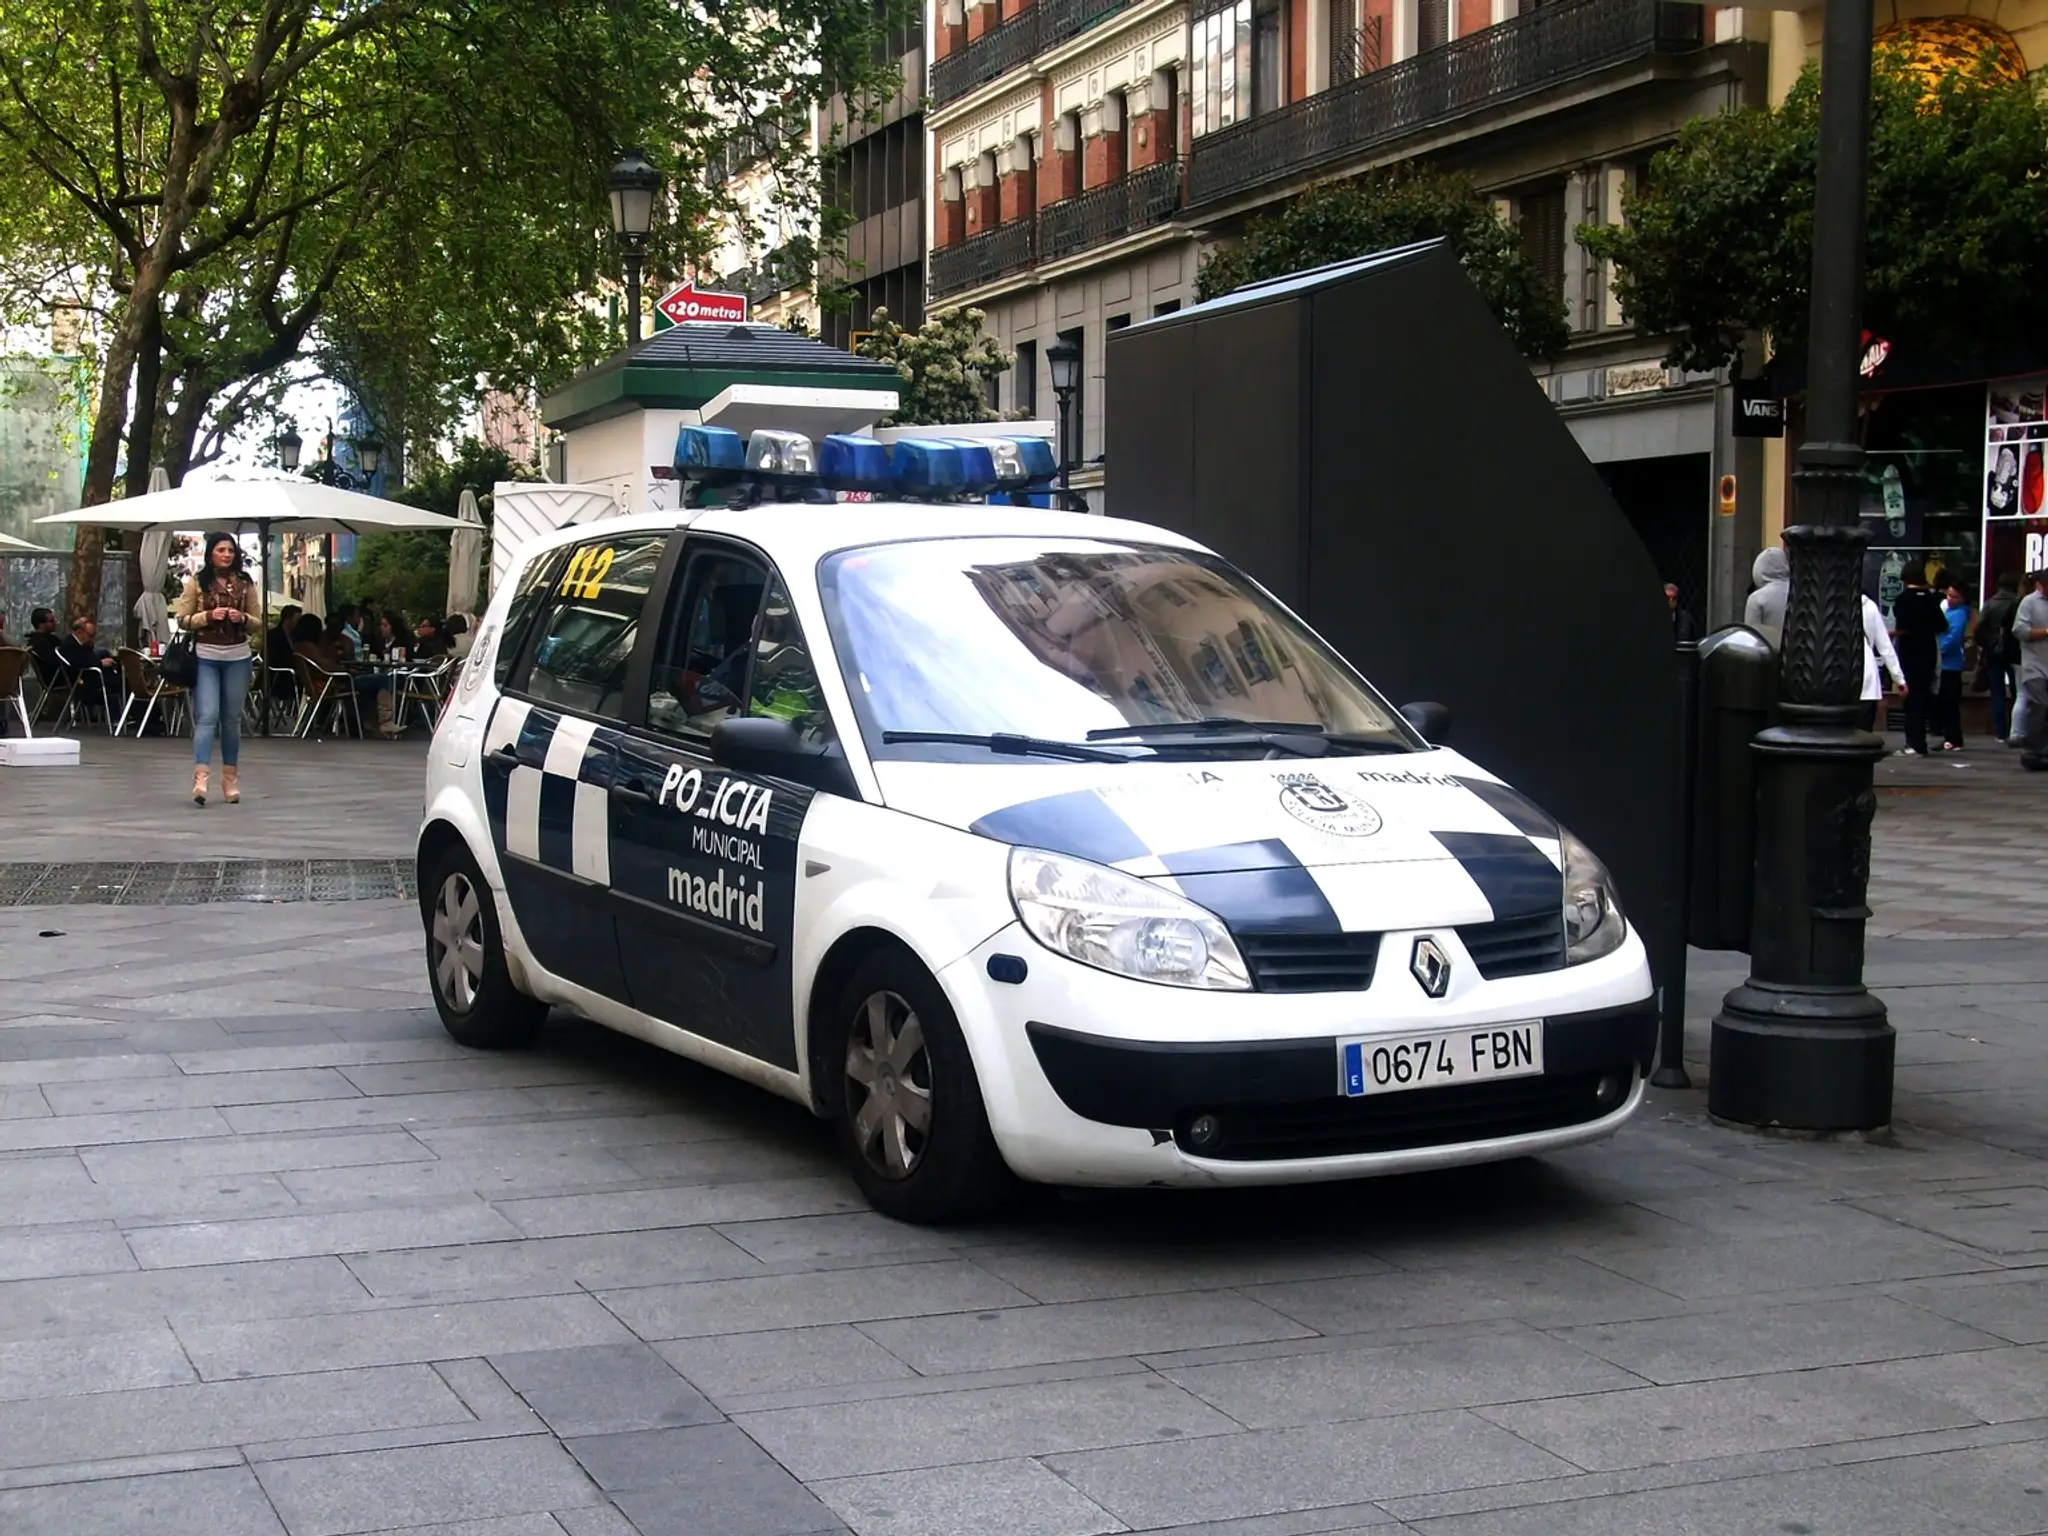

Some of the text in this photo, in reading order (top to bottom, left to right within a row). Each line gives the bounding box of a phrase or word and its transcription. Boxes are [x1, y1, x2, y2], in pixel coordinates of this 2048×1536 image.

[700, 306, 742, 319] metros
[1742, 399, 1780, 417] VANS
[561, 546, 615, 599] 112
[658, 763, 773, 836] POICIA
[1357, 770, 1461, 788] madrid
[692, 825, 764, 870] MUNICIPAL
[668, 867, 764, 932] madrid
[1372, 1027, 1532, 1085] 0674 FBN
[1351, 1074, 1358, 1086] E
